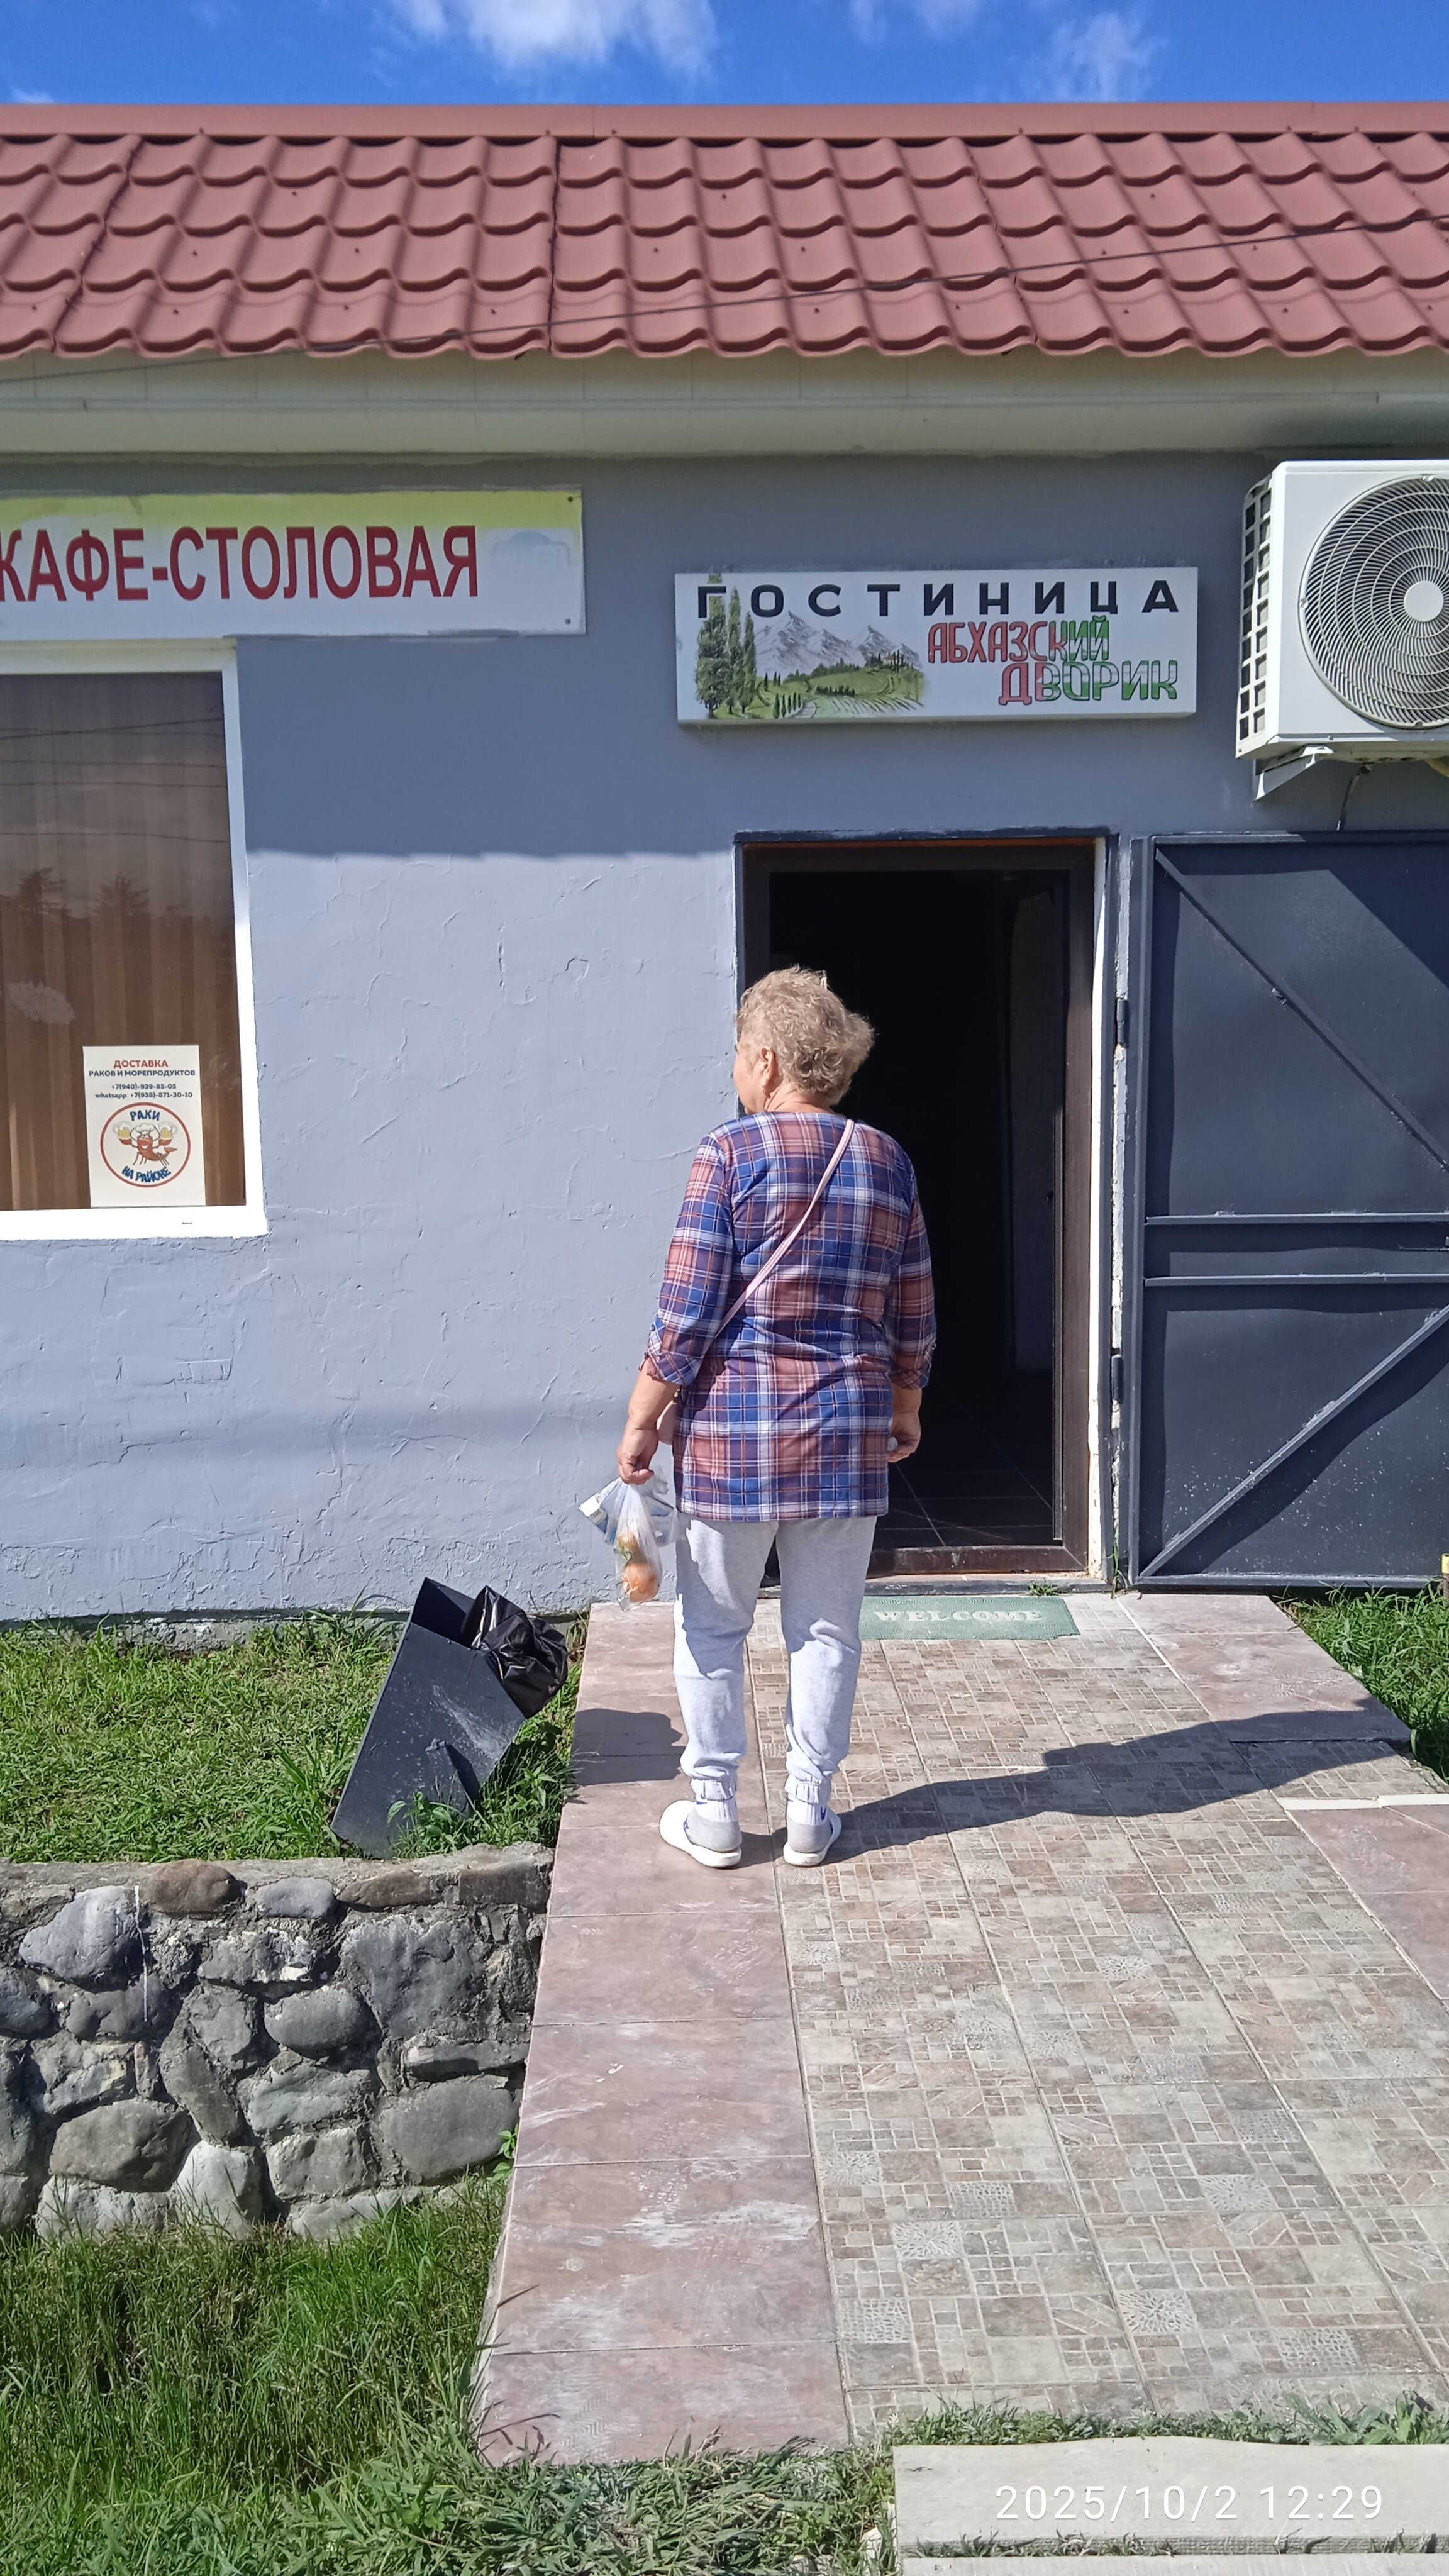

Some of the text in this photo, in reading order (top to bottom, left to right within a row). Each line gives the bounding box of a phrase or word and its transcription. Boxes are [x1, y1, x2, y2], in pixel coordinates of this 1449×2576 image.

[0, 525, 479, 602] КАФЕ-СТОЛОВАЯ
[697, 580, 1179, 619] ГОСТИНИЦА
[928, 615, 1109, 663] АБХАЗСКИЙ
[998, 660, 1177, 705] ДВОРИК
[113, 1060, 169, 1069] ДОСТАВКА
[130, 1109, 160, 1121] РАКИ
[122, 1165, 172, 1183] НА РАЙОНЕ
[873, 1610, 1043, 1622] WELCOME
